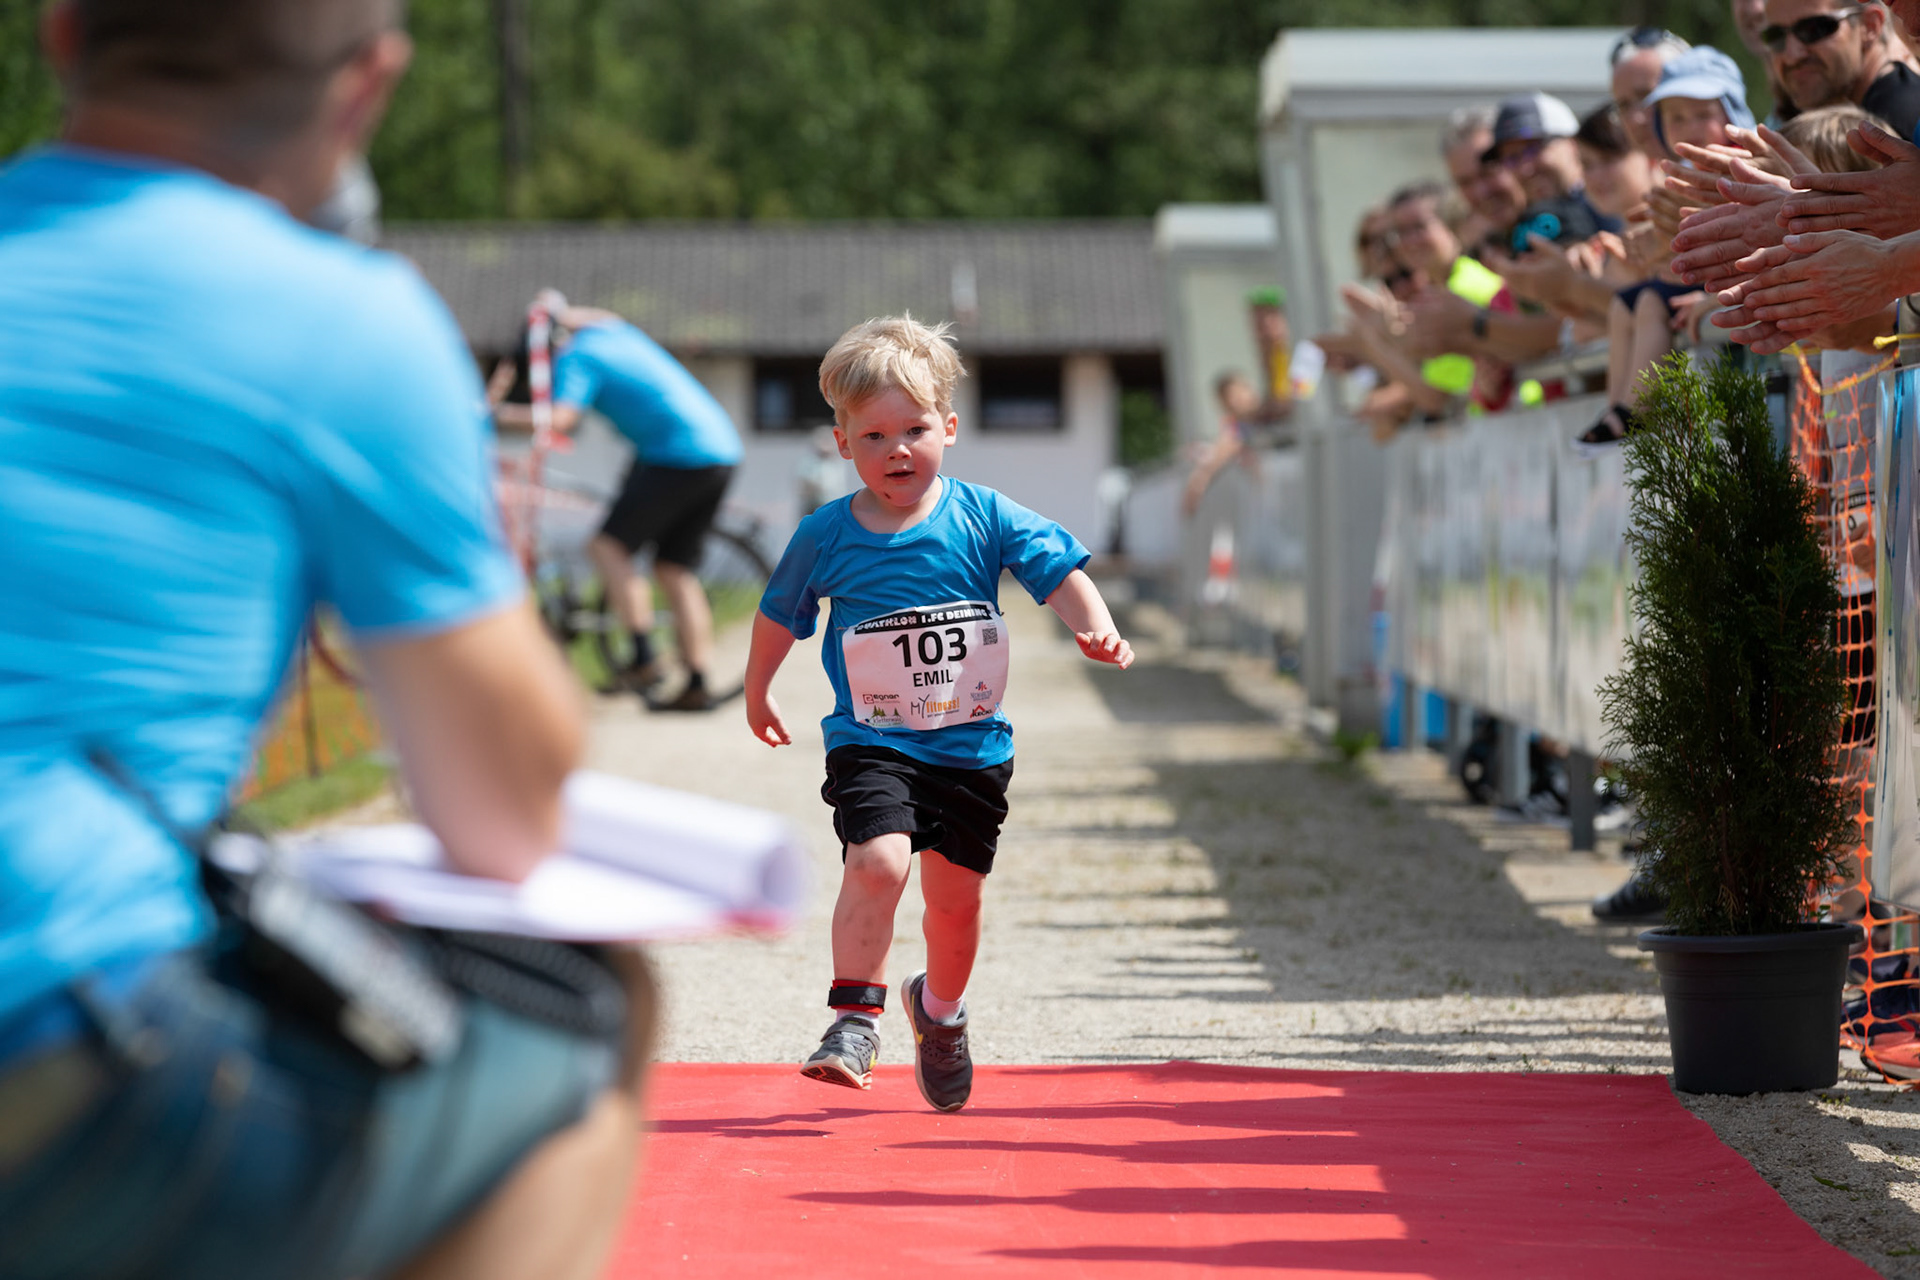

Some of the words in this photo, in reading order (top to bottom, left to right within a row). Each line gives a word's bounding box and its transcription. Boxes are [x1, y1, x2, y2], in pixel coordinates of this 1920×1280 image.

[946, 608, 988, 620] DEINING
[892, 627, 967, 667] 103
[913, 669, 953, 687] EMIL
